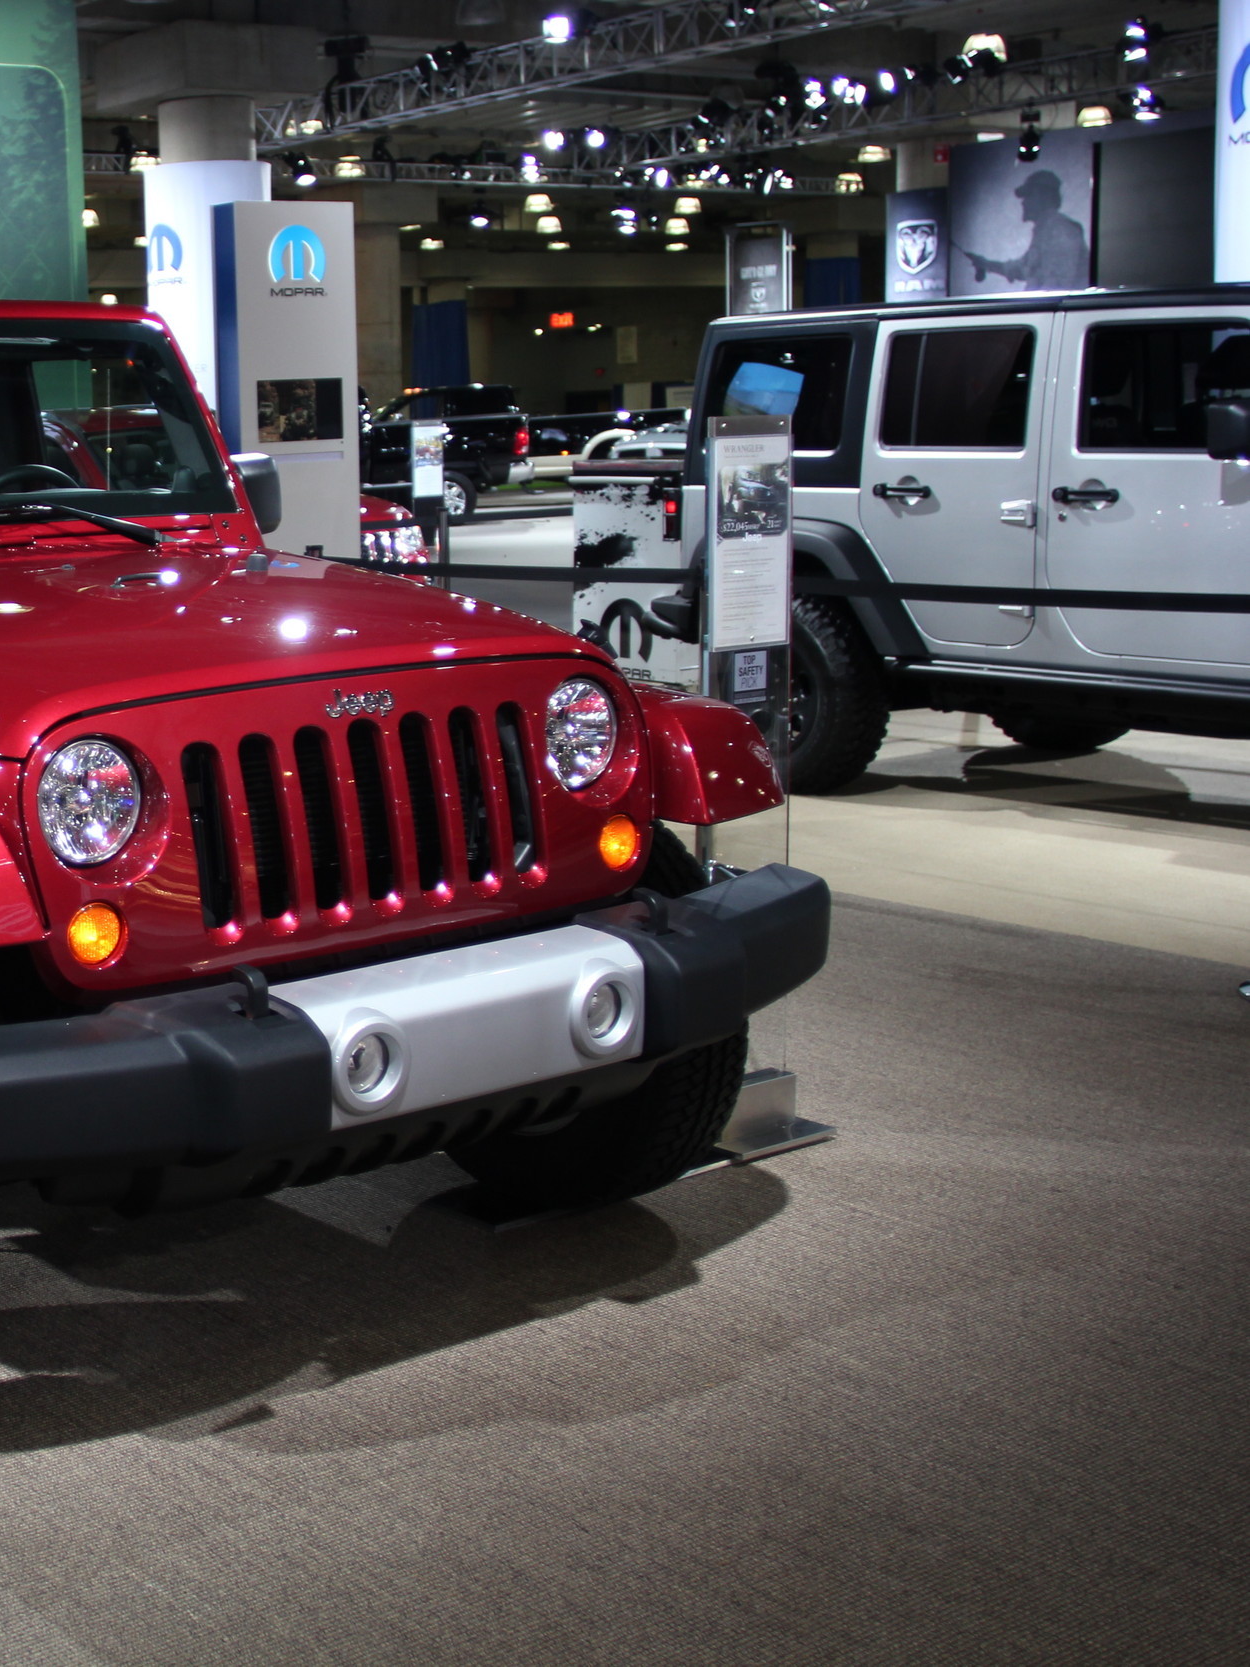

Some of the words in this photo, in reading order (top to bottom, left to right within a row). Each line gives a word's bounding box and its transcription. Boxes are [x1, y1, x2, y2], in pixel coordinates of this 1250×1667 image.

[270, 287, 325, 297] MOPAR
[724, 444, 765, 454] WRANGLER
[742, 532, 762, 543] Jeep
[743, 655, 756, 665] TOP
[622, 667, 652, 679] PAR
[738, 665, 764, 677] SAFETY
[741, 676, 758, 689] PICK
[325, 688, 395, 718] Jeep
